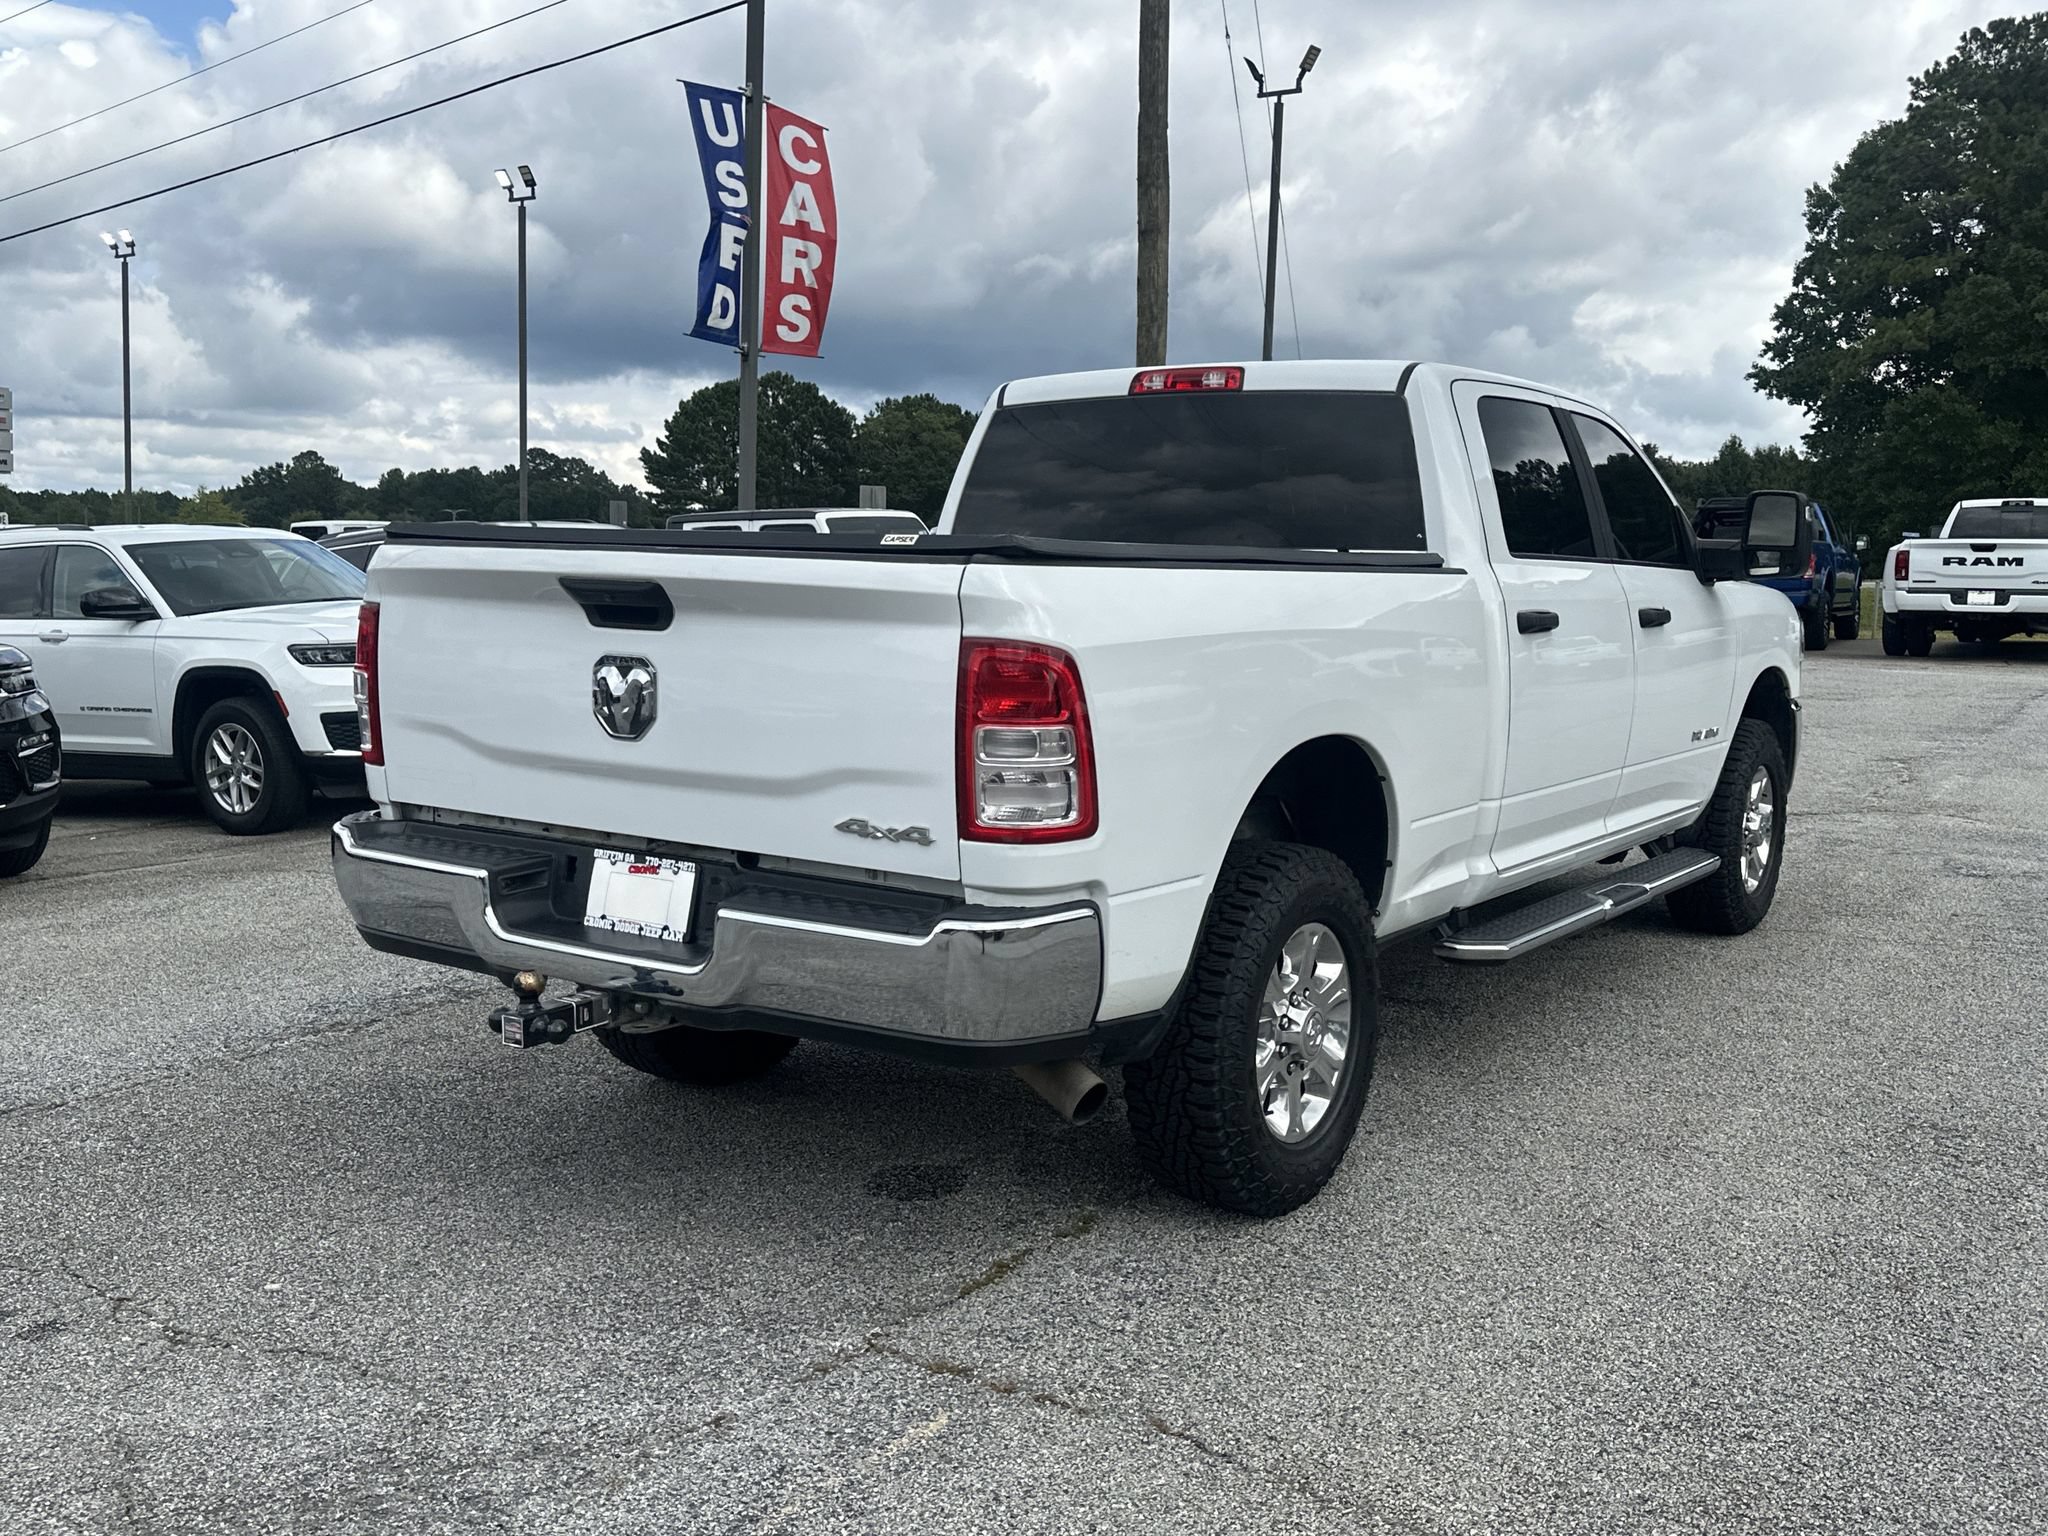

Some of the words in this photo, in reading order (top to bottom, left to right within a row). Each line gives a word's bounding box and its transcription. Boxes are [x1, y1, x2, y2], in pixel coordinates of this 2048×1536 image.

[700, 98, 748, 330] USED
[776, 124, 826, 343] CARS
[1942, 557, 2024, 567] RAM
[584, 916, 613, 930] CRONIC
[614, 921, 640, 935] DODGE
[641, 925, 662, 938] JEEP
[662, 928, 685, 942] RAM
